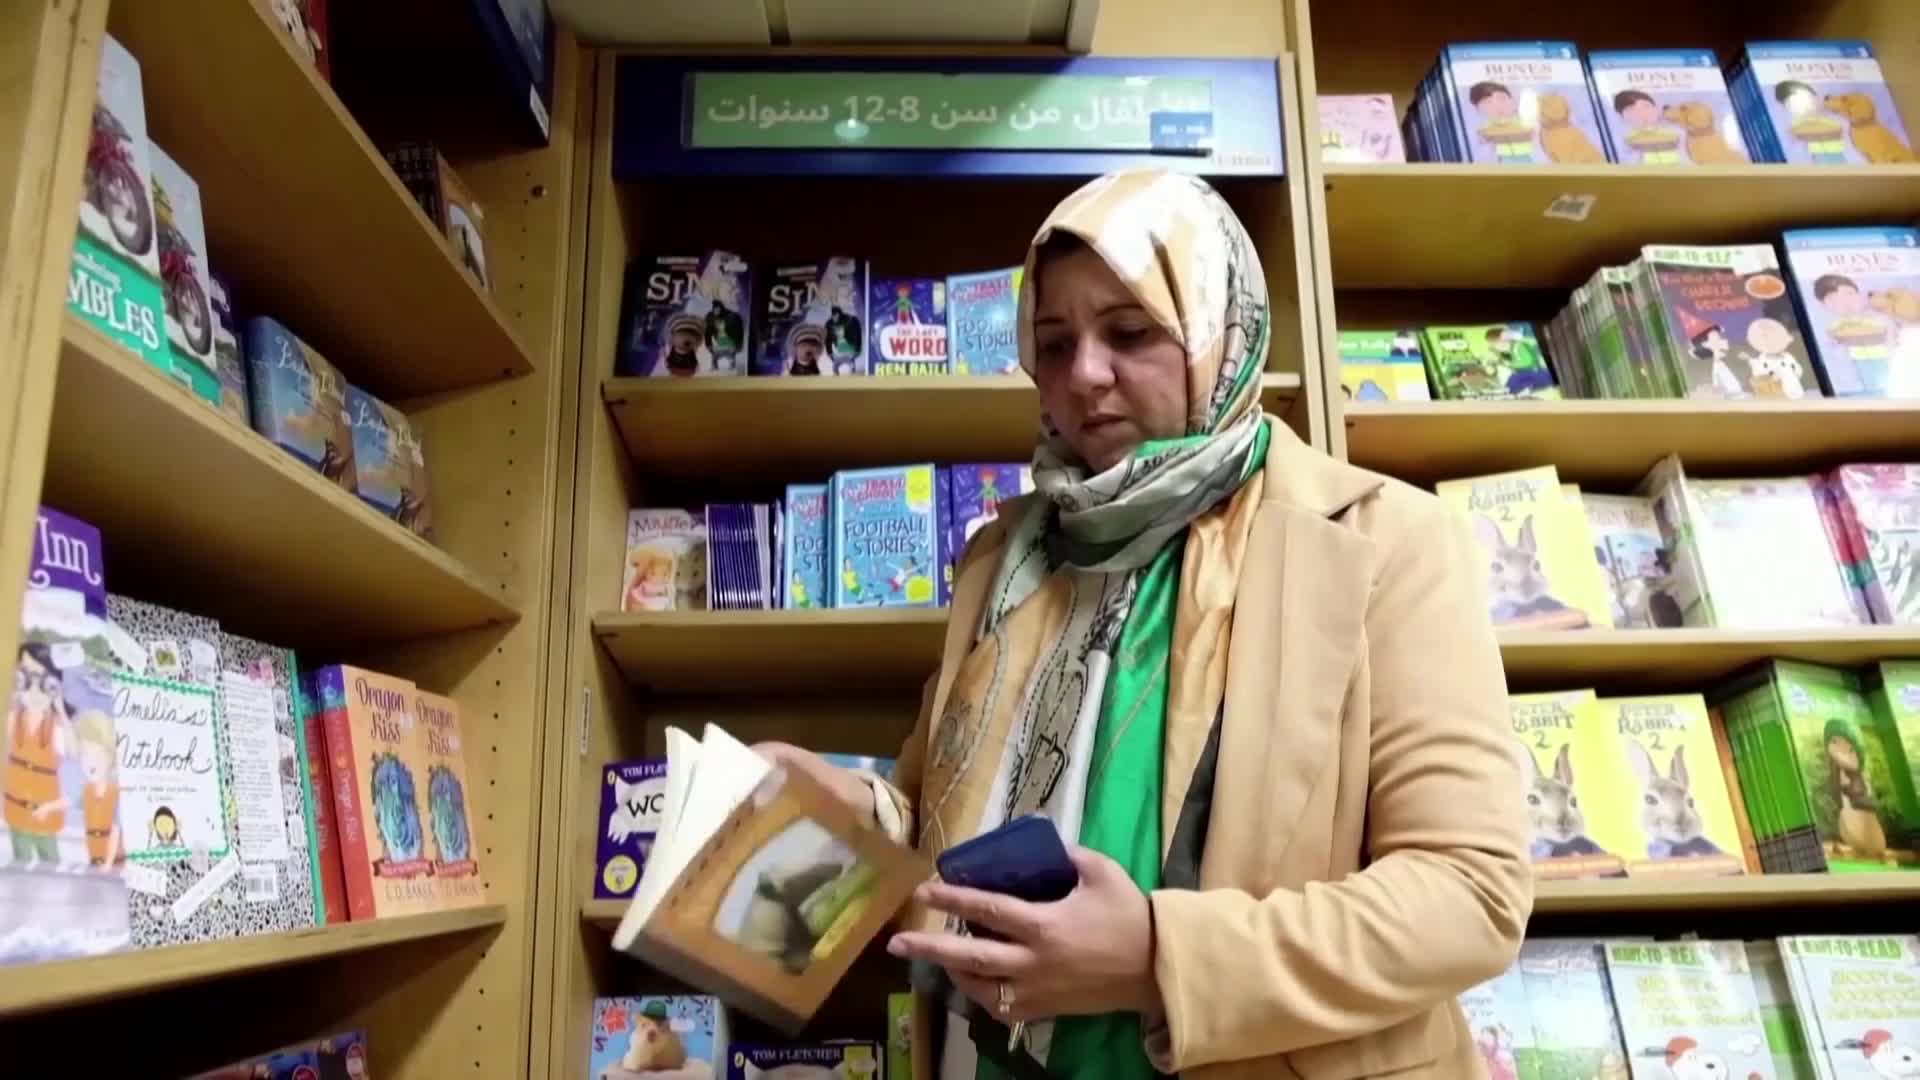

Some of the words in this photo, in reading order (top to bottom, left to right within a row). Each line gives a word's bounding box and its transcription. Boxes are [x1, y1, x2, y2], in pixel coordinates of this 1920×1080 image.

[708, 96, 830, 129] سنوات
[930, 102, 998, 131] سن
[1009, 104, 1061, 131] من
[1500, 506, 1516, 521] 2
[844, 516, 928, 539] FOOTBALL
[37, 516, 101, 586] Inn
[852, 536, 917, 557] STORIES
[113, 687, 208, 728] Amelia's
[355, 679, 405, 721] Dragon
[1534, 730, 1552, 749] 2
[1648, 731, 1664, 750] 2
[115, 734, 213, 774] Notebook
[623, 766, 643, 777] TOM
[753, 1049, 777, 1061] TOM
[779, 1047, 842, 1060] FLETCHER
